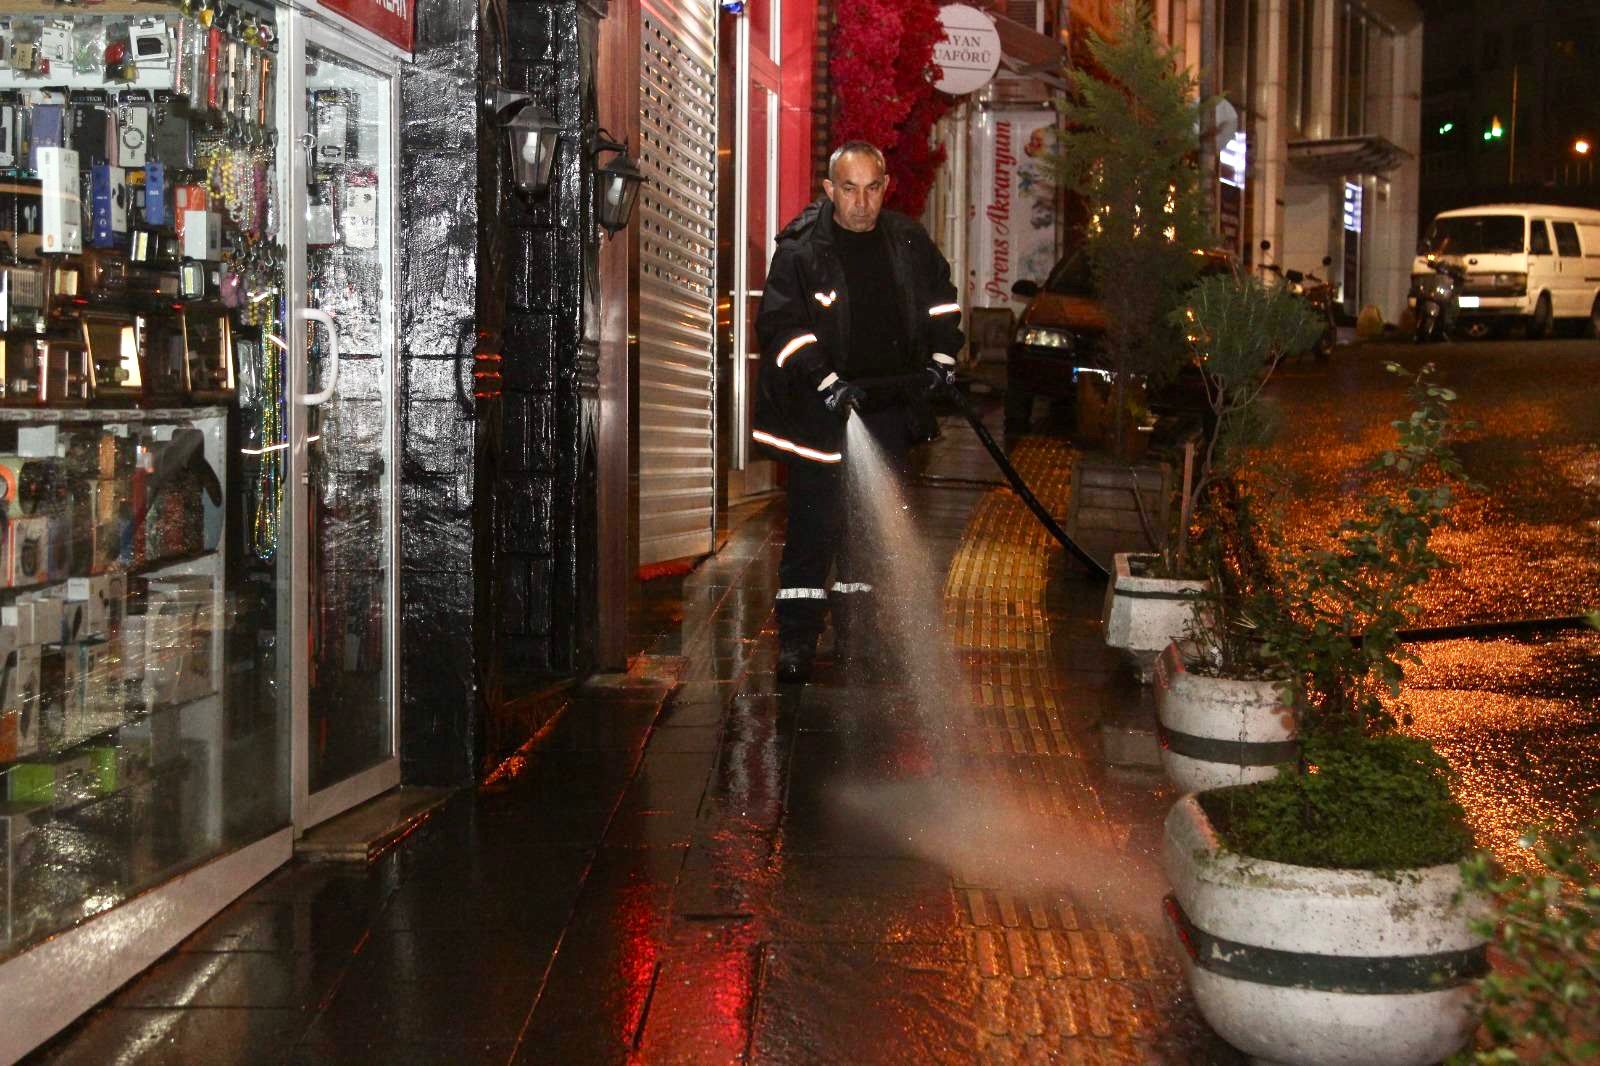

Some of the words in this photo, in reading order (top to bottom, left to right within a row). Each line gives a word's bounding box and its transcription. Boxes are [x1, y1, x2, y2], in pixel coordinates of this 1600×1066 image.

[932, 48, 993, 64] UAFÖRÜ
[950, 34, 982, 48] YAN
[986, 120, 1017, 236] Akvaryum
[985, 238, 1009, 302] Prens
